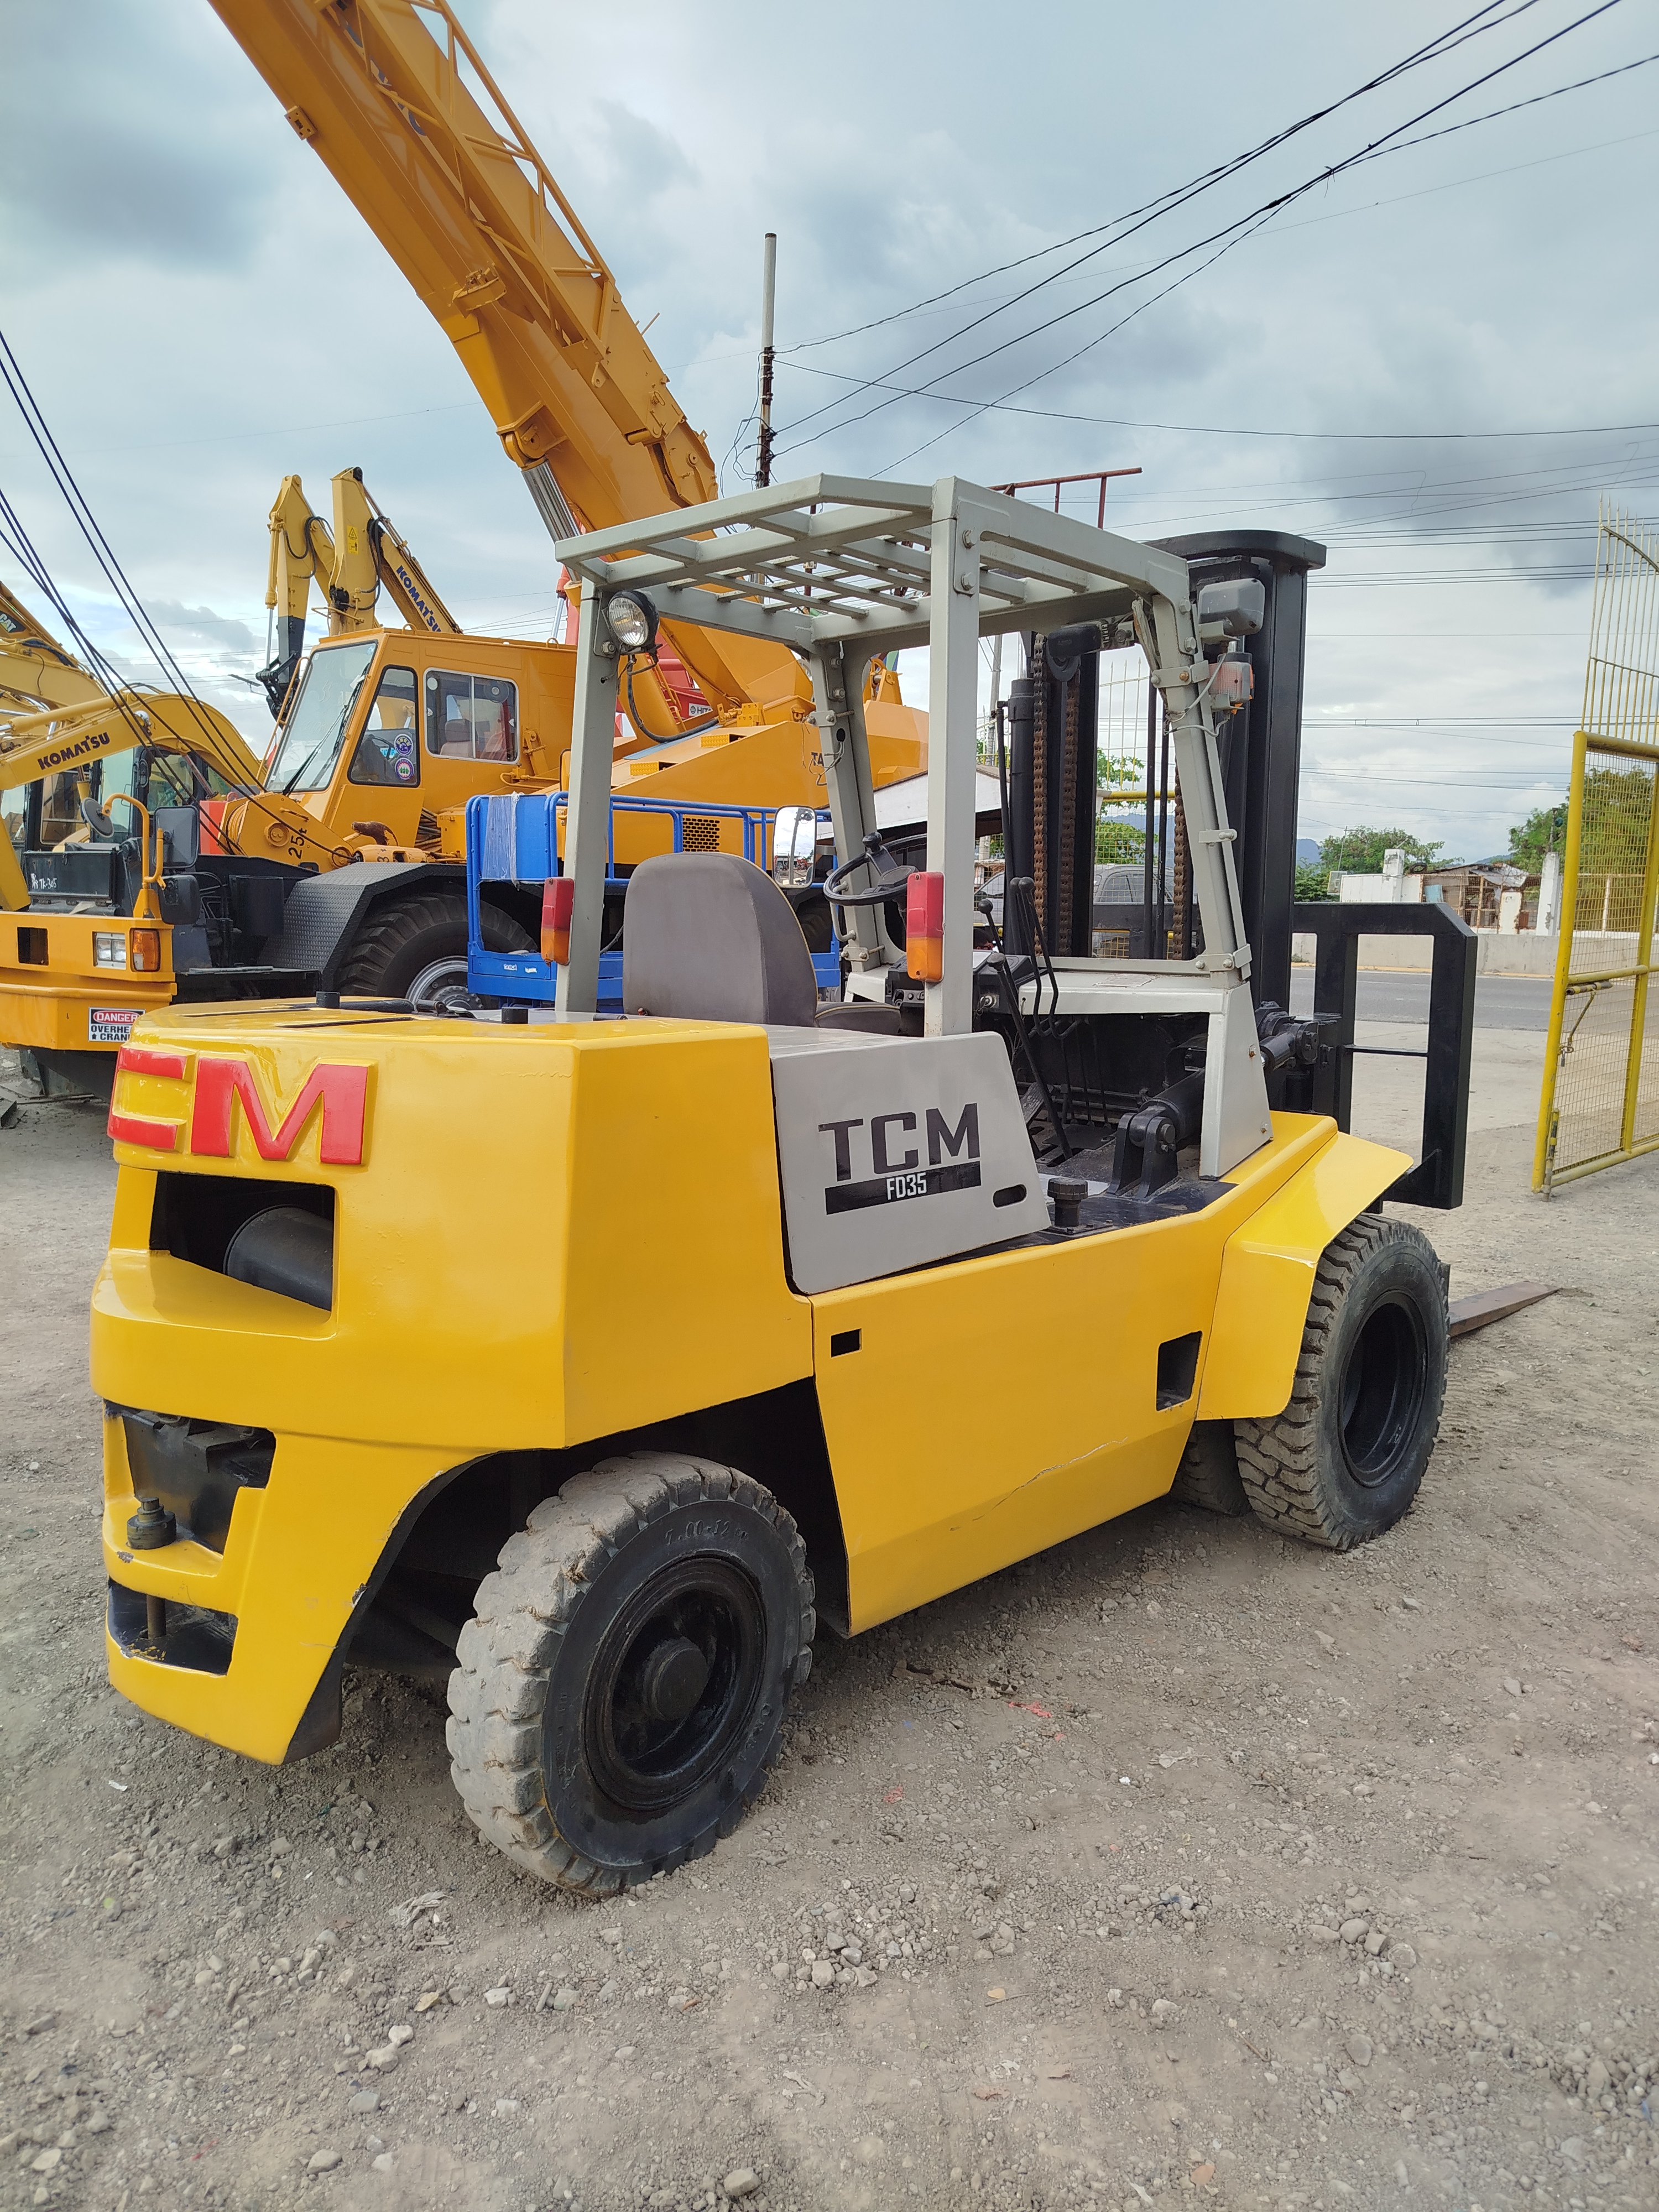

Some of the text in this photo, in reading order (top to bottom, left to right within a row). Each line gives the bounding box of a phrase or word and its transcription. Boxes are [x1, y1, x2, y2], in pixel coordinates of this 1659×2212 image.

[37, 732, 110, 770] KOMATSU
[91, 1025, 130, 1034] OVERHE
[97, 1013, 138, 1022] DANGER
[818, 1103, 980, 1182] TCM
[886, 1172, 927, 1201] FD35
